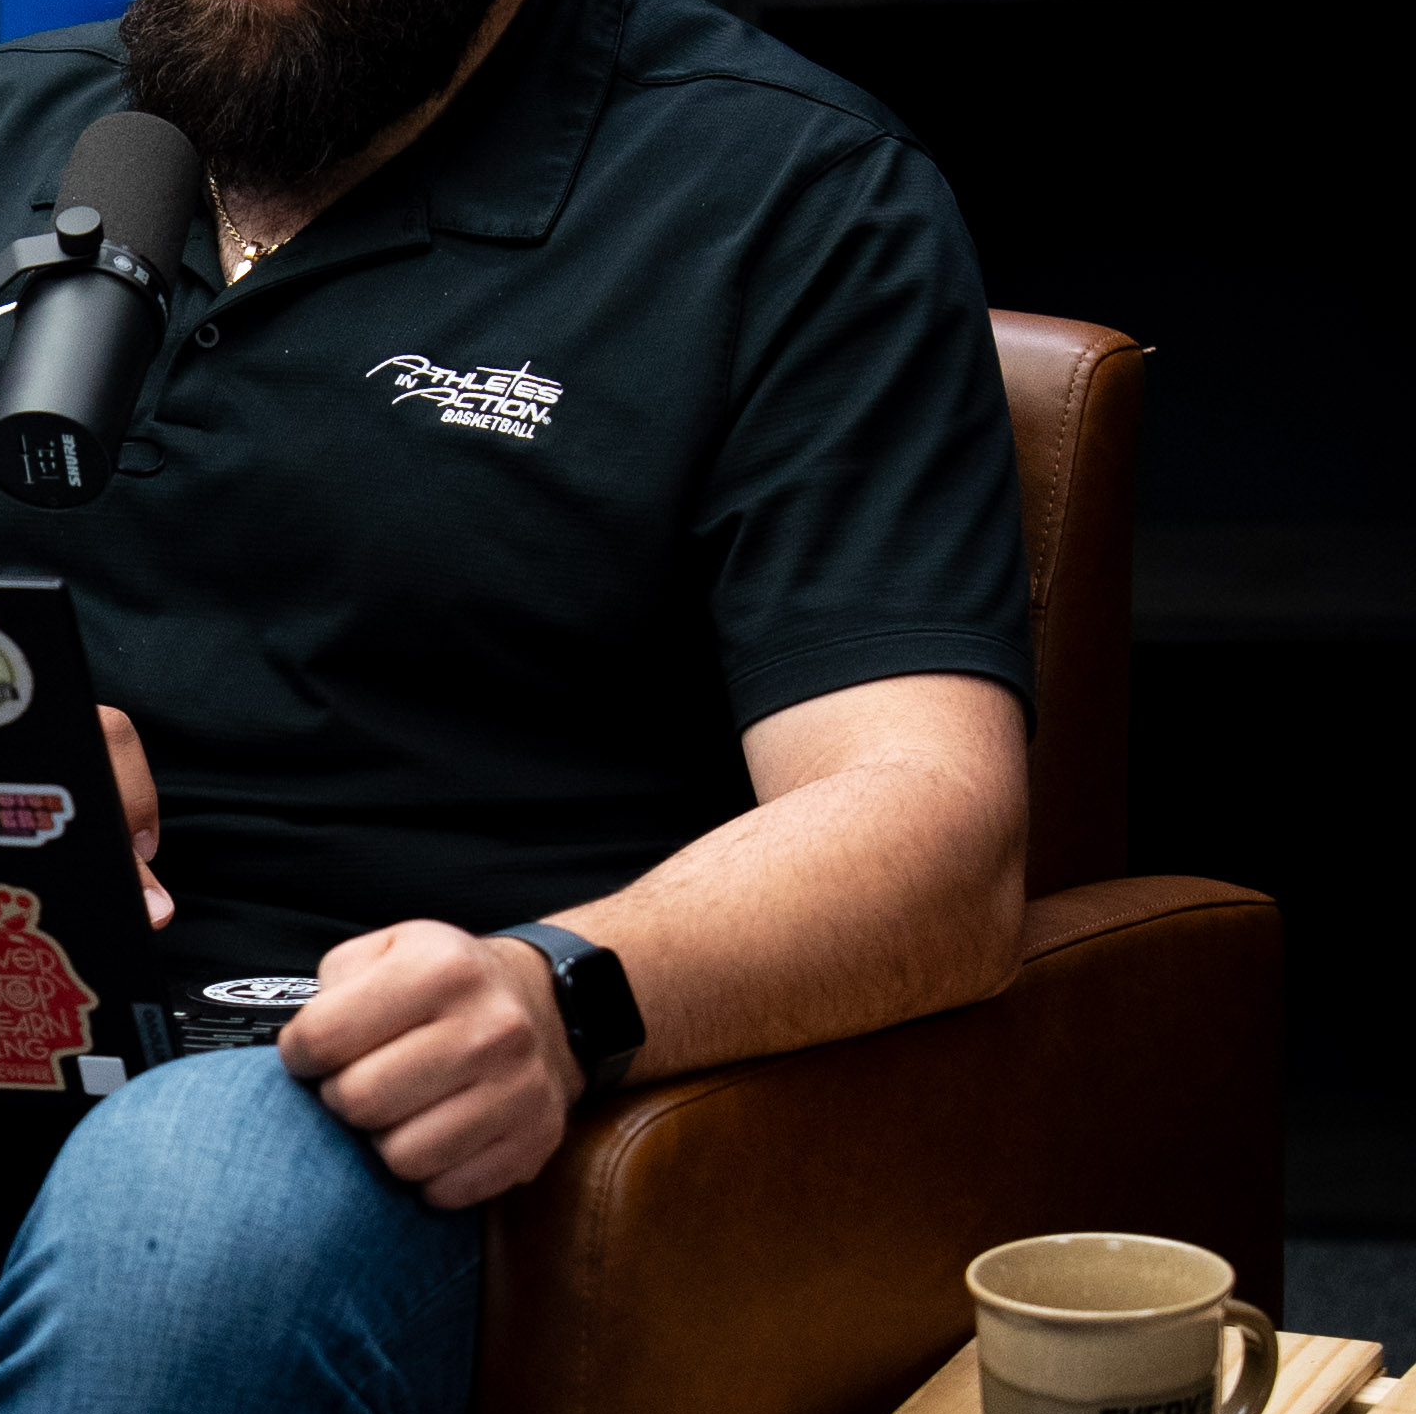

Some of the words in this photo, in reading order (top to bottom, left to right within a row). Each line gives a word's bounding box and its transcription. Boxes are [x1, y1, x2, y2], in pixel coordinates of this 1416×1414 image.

[365, 354, 564, 405] ATHLETES
[394, 373, 419, 389] IN
[410, 408, 535, 440] BASKETBALL
[61, 433, 82, 488] SHURE
